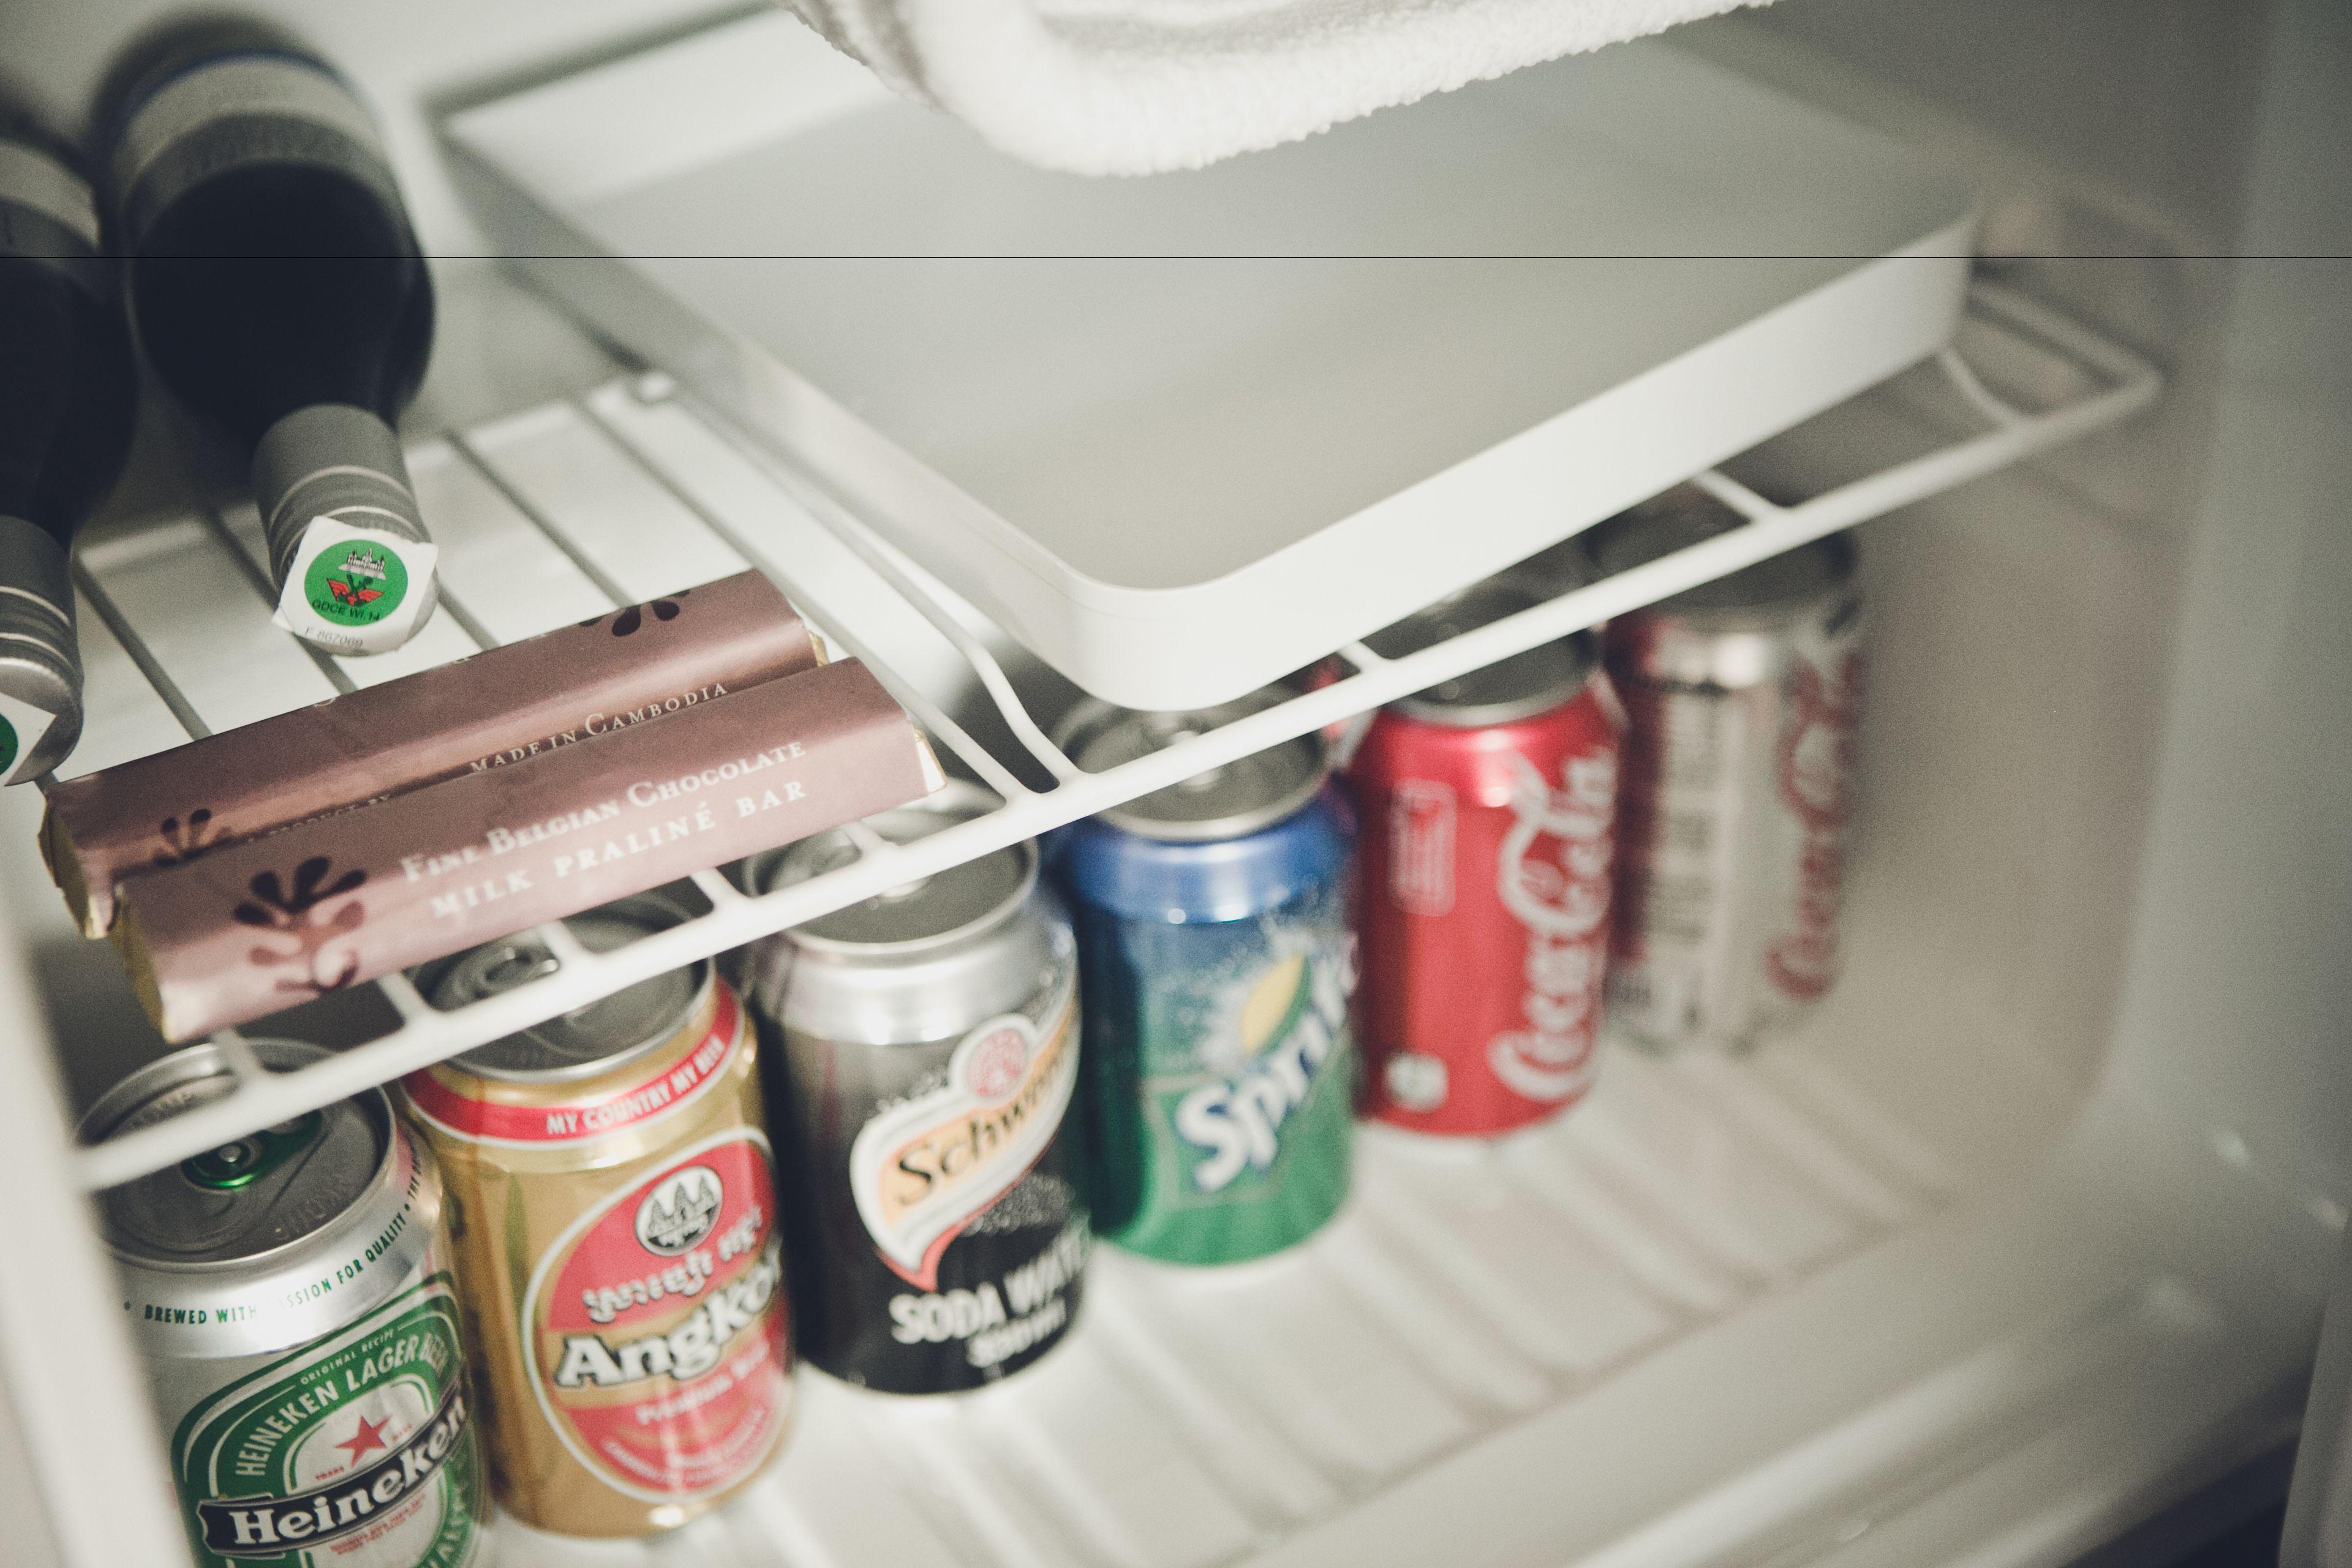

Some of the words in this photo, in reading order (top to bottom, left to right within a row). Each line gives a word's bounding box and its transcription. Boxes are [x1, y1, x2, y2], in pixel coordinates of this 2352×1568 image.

[470, 742, 542, 774] MADE
[551, 729, 576, 749] IN
[627, 741, 807, 807] CHOCOLATE
[431, 869, 535, 918] MILK
[553, 800, 716, 878] PRALINÉ
[736, 780, 807, 819] BAR
[546, 1112, 577, 1134] MY
[582, 1082, 671, 1130] COUNTRY
[669, 1065, 698, 1095] MY
[145, 1303, 207, 1325] BREWED
[216, 1305, 257, 1324] WITH
[336, 1259, 364, 1284] FOR
[365, 1212, 407, 1263] QUALITY
[889, 1283, 1008, 1344] SODA
[235, 1380, 339, 1476] HEINEKEN
[345, 1333, 420, 1392] LAGER
[228, 1397, 466, 1545] Heineken
